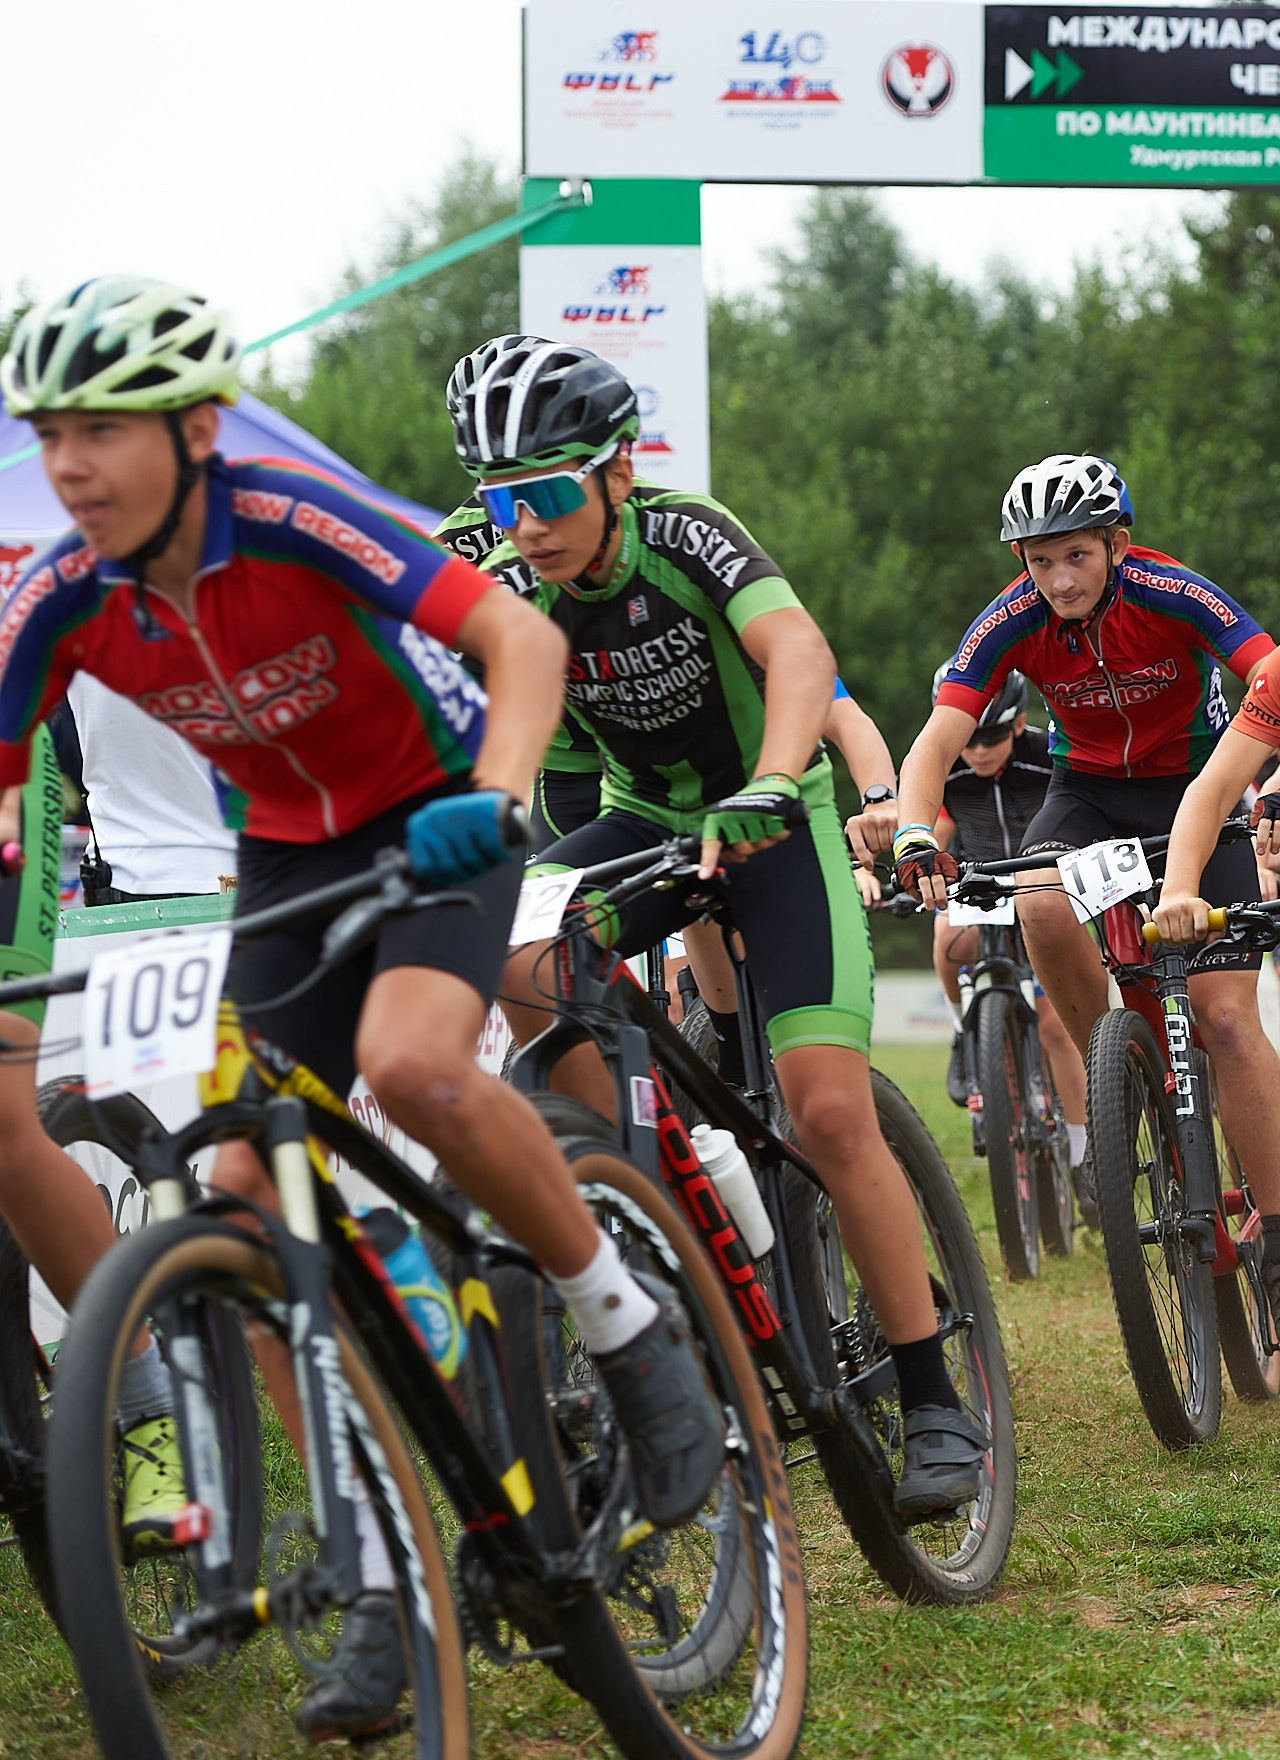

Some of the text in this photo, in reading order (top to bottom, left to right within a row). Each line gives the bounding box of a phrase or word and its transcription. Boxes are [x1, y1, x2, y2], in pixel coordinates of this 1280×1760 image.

[1056, 111, 1101, 137] ПО
[1130, 145, 1261, 170] Удмуртская
[291, 507, 406, 587] REGION
[644, 509, 750, 589] RUSSIA
[1008, 587, 1040, 616] REG
[1185, 581, 1240, 628] REGION
[566, 616, 708, 682] STRORETSK
[954, 606, 1008, 673] MOSCOW
[633, 653, 713, 701] SCHOOL
[1041, 658, 1179, 698] MOSCOW
[1064, 843, 1140, 896] 113
[97, 956, 212, 1049] 109
